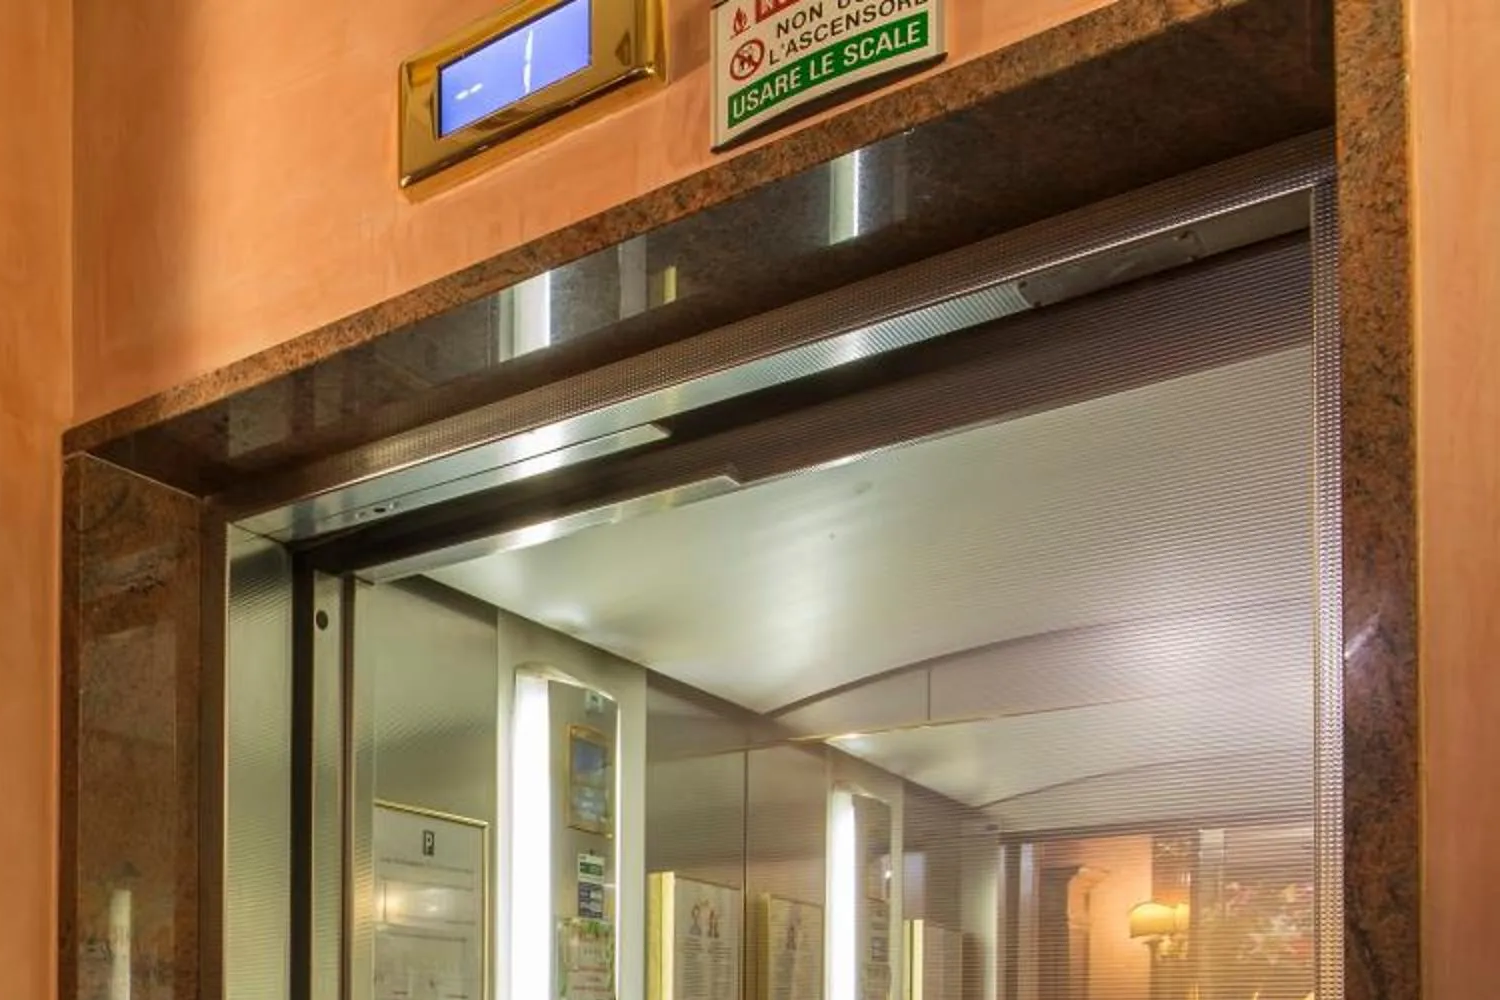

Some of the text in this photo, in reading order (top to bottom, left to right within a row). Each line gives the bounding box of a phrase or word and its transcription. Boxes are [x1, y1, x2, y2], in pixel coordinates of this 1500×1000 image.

[776, 2, 823, 38] NON
[733, 21, 921, 118] USARE LE SCALE
